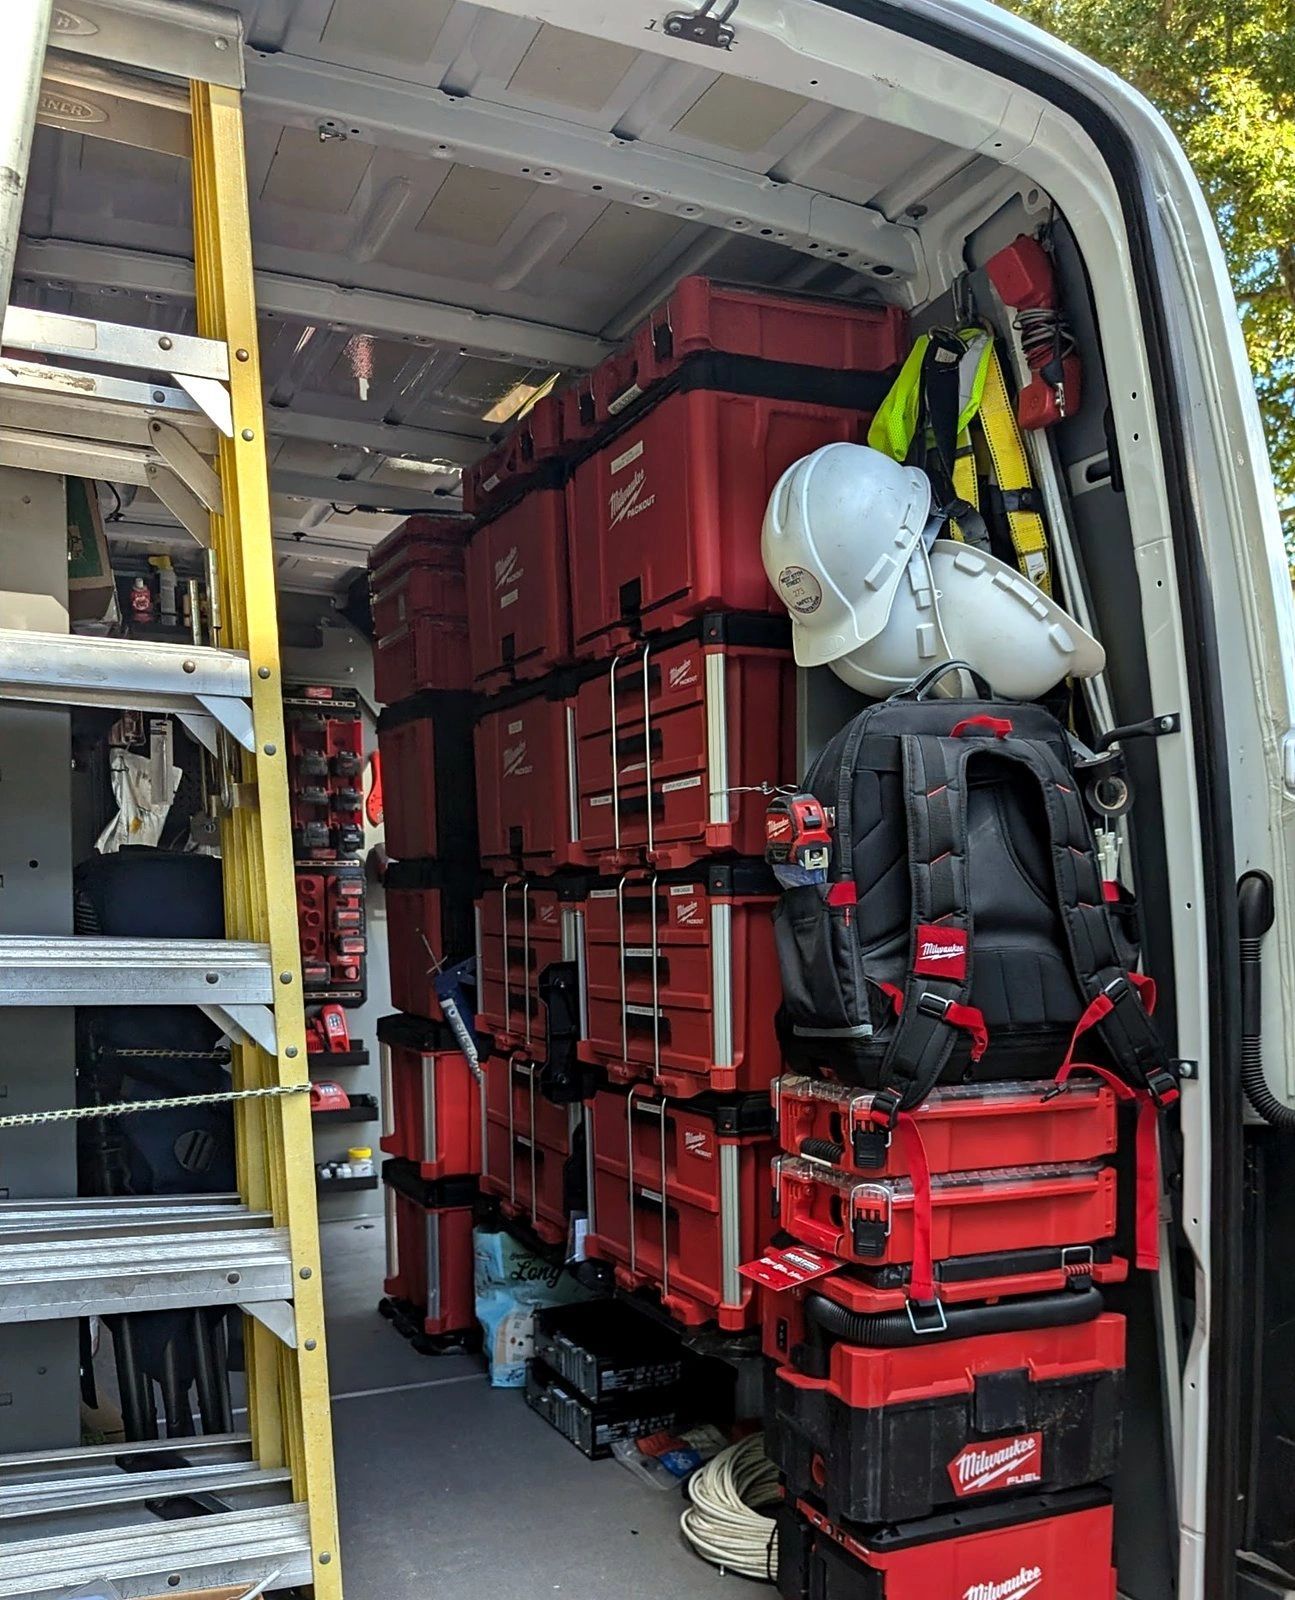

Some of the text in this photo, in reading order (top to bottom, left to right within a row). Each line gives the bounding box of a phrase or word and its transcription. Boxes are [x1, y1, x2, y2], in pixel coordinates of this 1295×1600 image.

[919, 942, 965, 956] Milwaukee
[956, 1437, 1036, 1484] Milwaukee
[1006, 1472, 1041, 1486] FUEL
[962, 1566, 1042, 1600] Milwaukee
